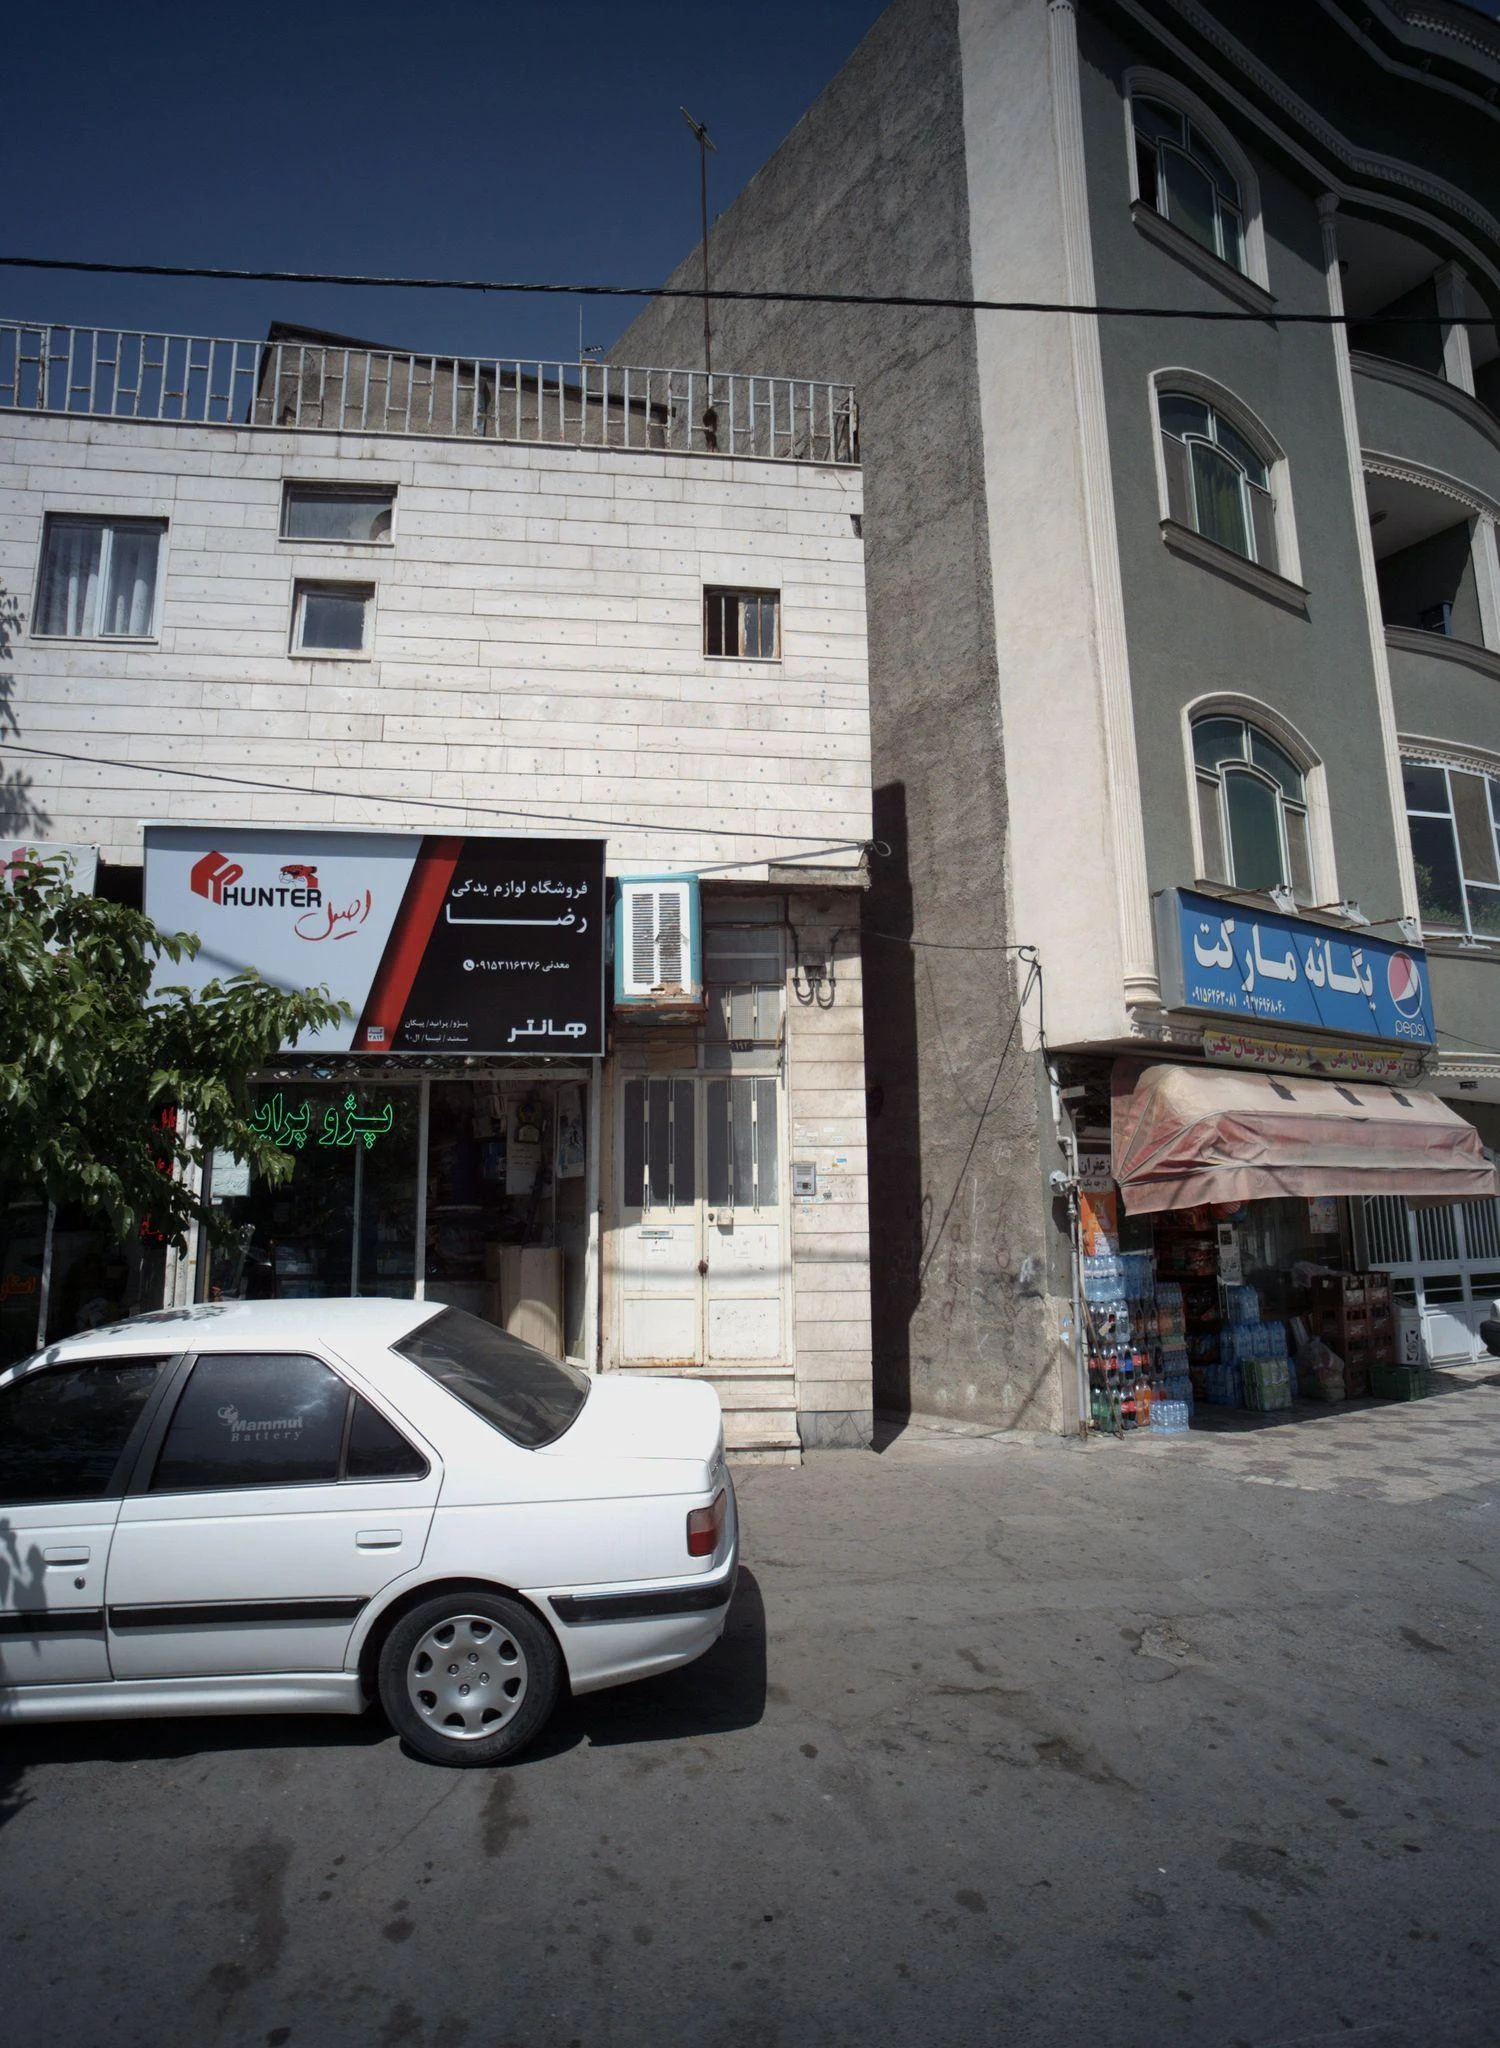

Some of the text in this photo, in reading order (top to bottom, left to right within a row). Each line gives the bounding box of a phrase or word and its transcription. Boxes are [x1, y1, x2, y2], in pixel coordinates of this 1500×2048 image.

[222, 887, 322, 908] HUNTER
[451, 879, 588, 898] فروشگاه لوازم یدکی
[445, 903, 588, 933] رضا
[541, 961, 570, 972] معدنی
[1193, 917, 1377, 1012] یگانه مارکت
[507, 1019, 587, 1043] هانتر
[1395, 1017, 1425, 1038] pepsi
[319, 1093, 394, 1149] پژو
[231, 1415, 303, 1432] Mammut
[231, 1431, 301, 1442] Battery
